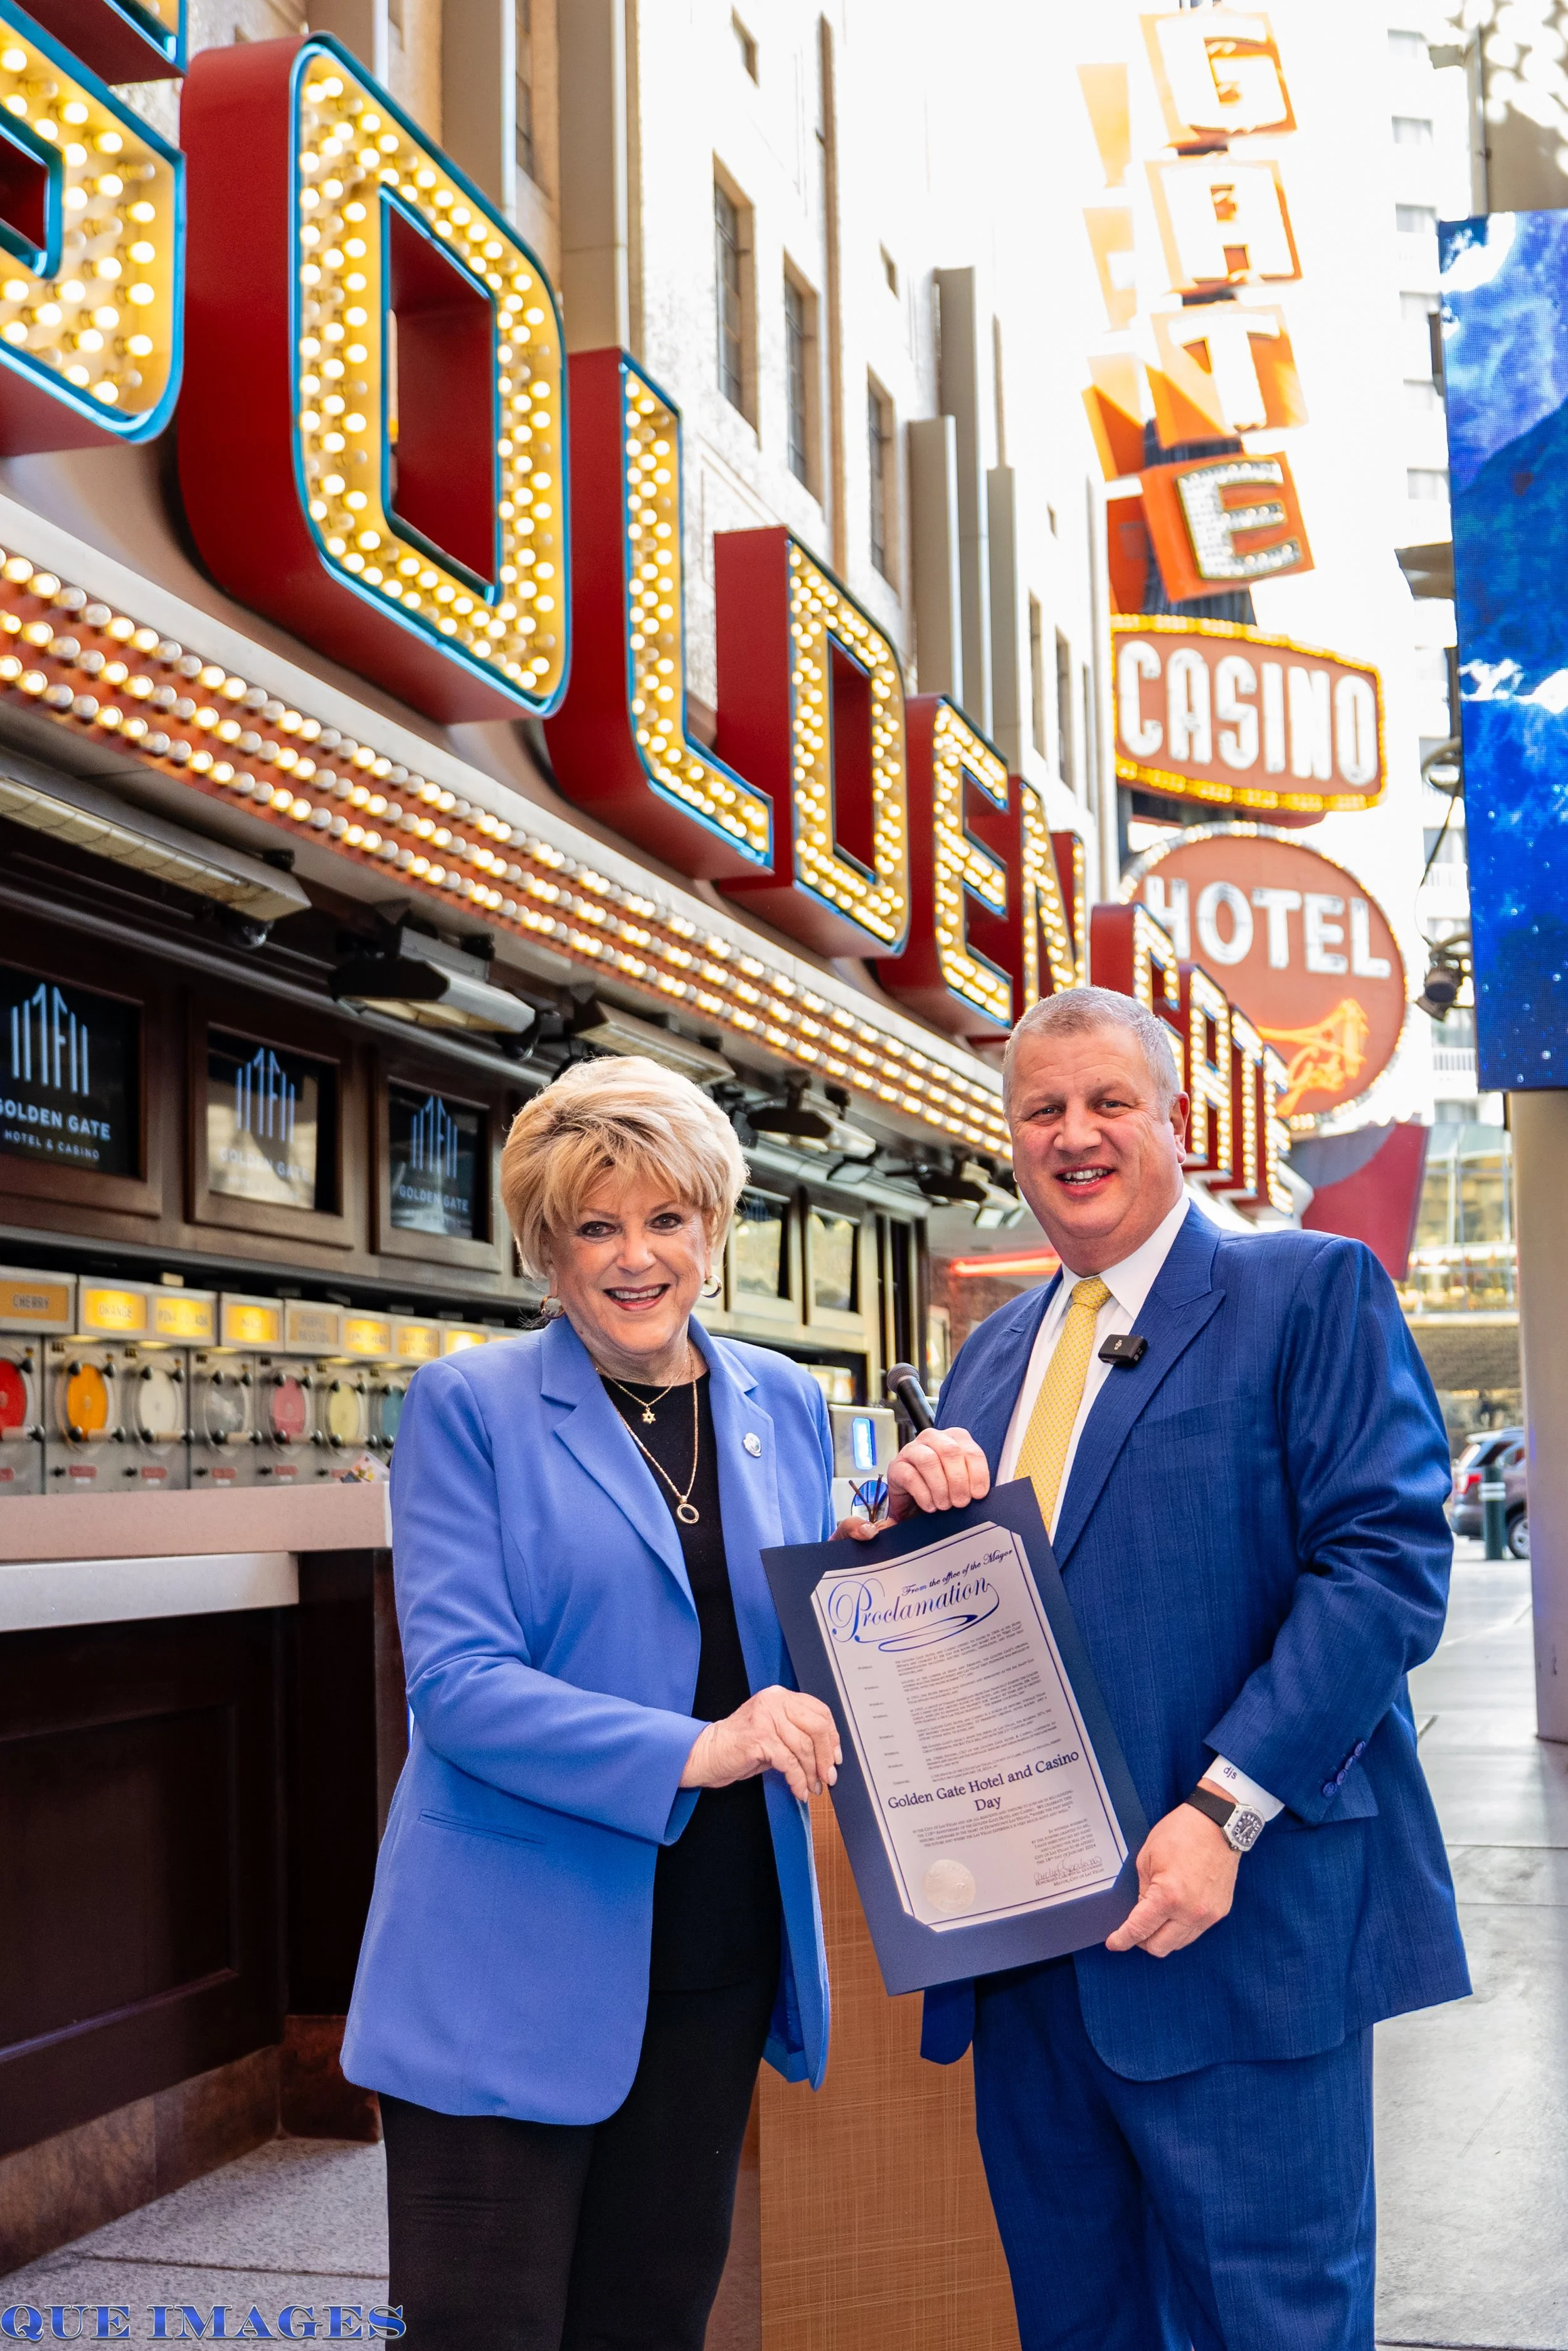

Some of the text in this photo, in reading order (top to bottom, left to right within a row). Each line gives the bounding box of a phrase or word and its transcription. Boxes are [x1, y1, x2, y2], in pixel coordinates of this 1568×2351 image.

[1154, 14, 1303, 581] GATE
[1118, 640, 1378, 787] CASINO
[1144, 874, 1391, 979] HOTEL
[67, 1114, 111, 1140] GATE
[4, 1130, 43, 1149] HOTEL
[58, 1141, 100, 1160] CASINO
[399, 1184, 469, 1213] GOLDEN GATE
[13, 1294, 50, 1309] CHERRY
[98, 1304, 132, 1319] ORANGE
[901, 1549, 1014, 1596] From the office of the Mayor
[828, 1577, 1000, 1652] Proclamation
[887, 1793, 934, 1809] Golden
[936, 1786, 967, 1800] Gate
[968, 1773, 1004, 1793] Hotel
[1007, 1765, 1033, 1783] and
[1035, 1751, 1079, 1774] Casino
[1223, 1766, 1238, 1780] djs
[974, 1796, 1002, 1812] Day
